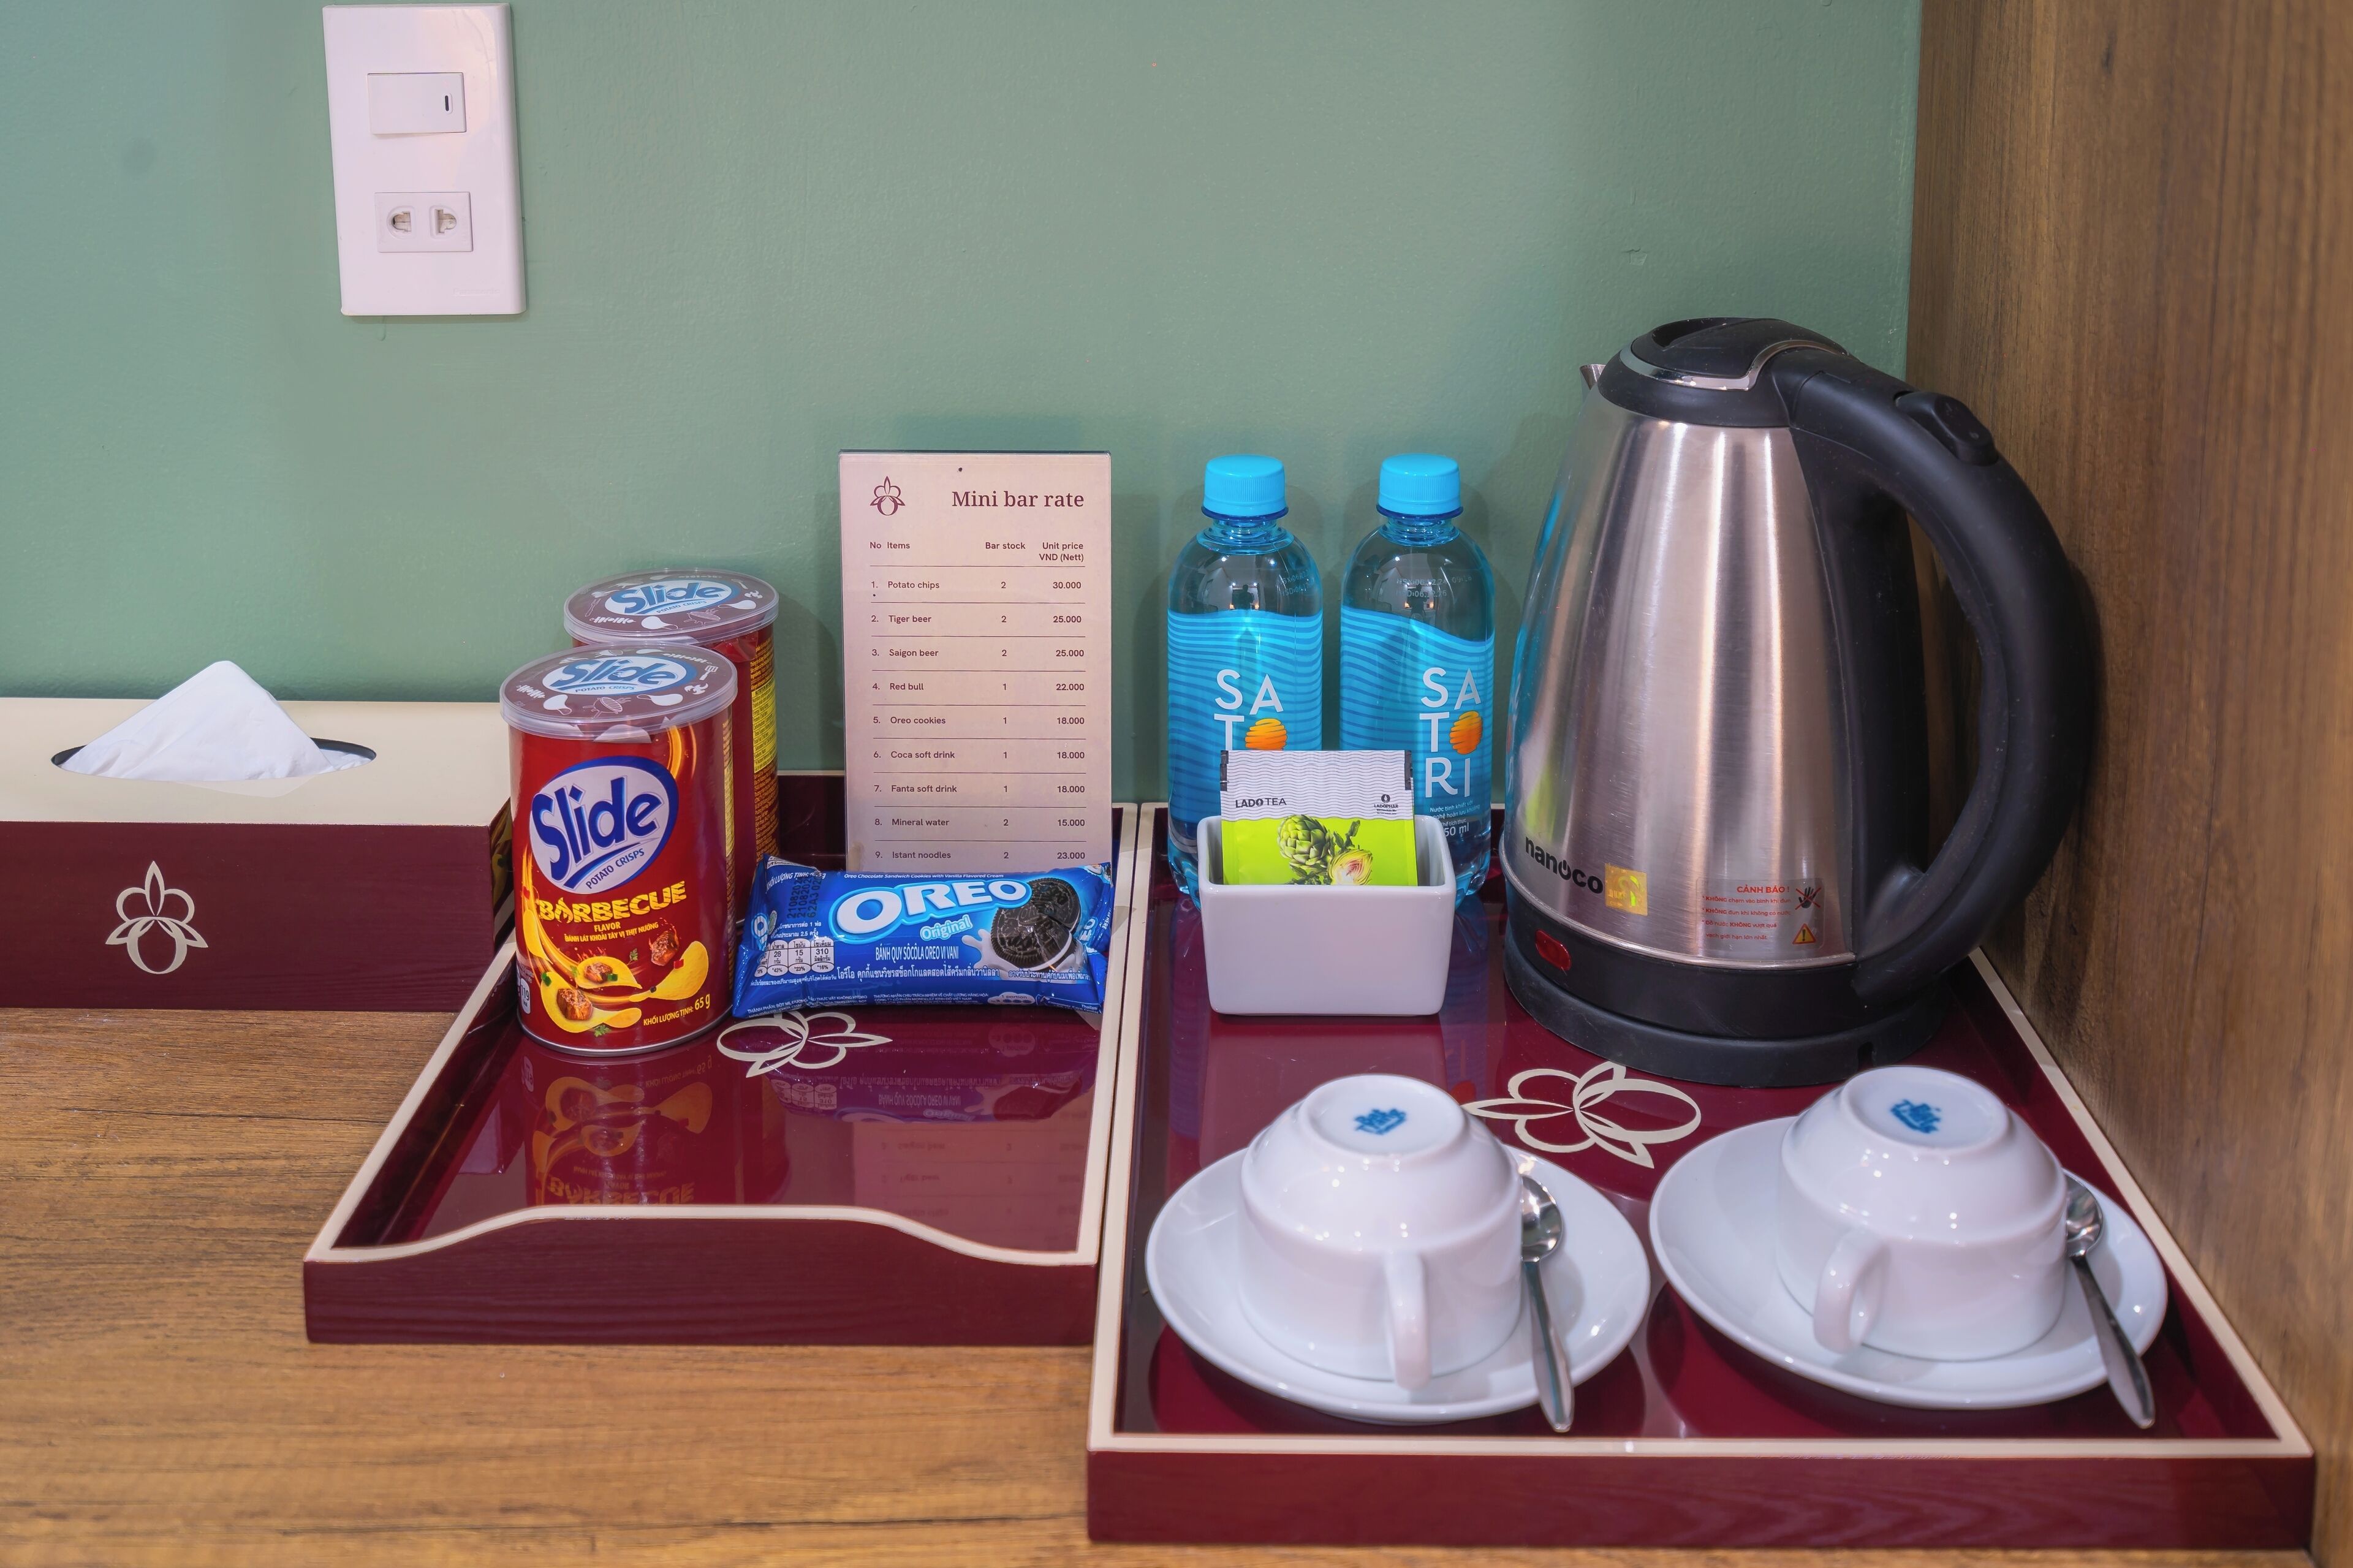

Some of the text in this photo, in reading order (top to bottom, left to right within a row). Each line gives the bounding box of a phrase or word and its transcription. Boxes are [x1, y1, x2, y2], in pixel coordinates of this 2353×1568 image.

[952, 490, 1085, 507] Mini bar rate
[1062, 542, 1084, 551] price
[1039, 553, 1084, 563] VND (Nett)
[917, 581, 940, 591] chips
[1052, 581, 1082, 589] 30.000
[610, 581, 727, 614] Slide
[656, 604, 681, 613] POTATO
[889, 615, 910, 624] Tiger
[889, 648, 917, 658] Saigon
[1055, 649, 1085, 657] 25.000
[550, 654, 676, 685] Slide
[1056, 683, 1085, 691] 22.000
[1002, 716, 1007, 725] 1
[1235, 797, 1287, 808] LADO TEA
[531, 776, 662, 881] Slide
[1444, 822, 1469, 837] 50 ml
[585, 847, 645, 890] POTATO CRISPS
[1525, 836, 1604, 895] nanoco
[1737, 884, 1764, 893] CẢNH
[539, 880, 687, 923] BARBECUE
[836, 880, 1027, 936] OREO
[593, 922, 621, 933] FLAVOR
[921, 915, 971, 940] Original
[875, 942, 890, 961] BÁNH
[891, 946, 903, 963] QUY
[925, 945, 940, 960] OREO
[946, 945, 959, 960] VANI
[694, 998, 705, 1012] 65
[705, 994, 711, 1009] g
